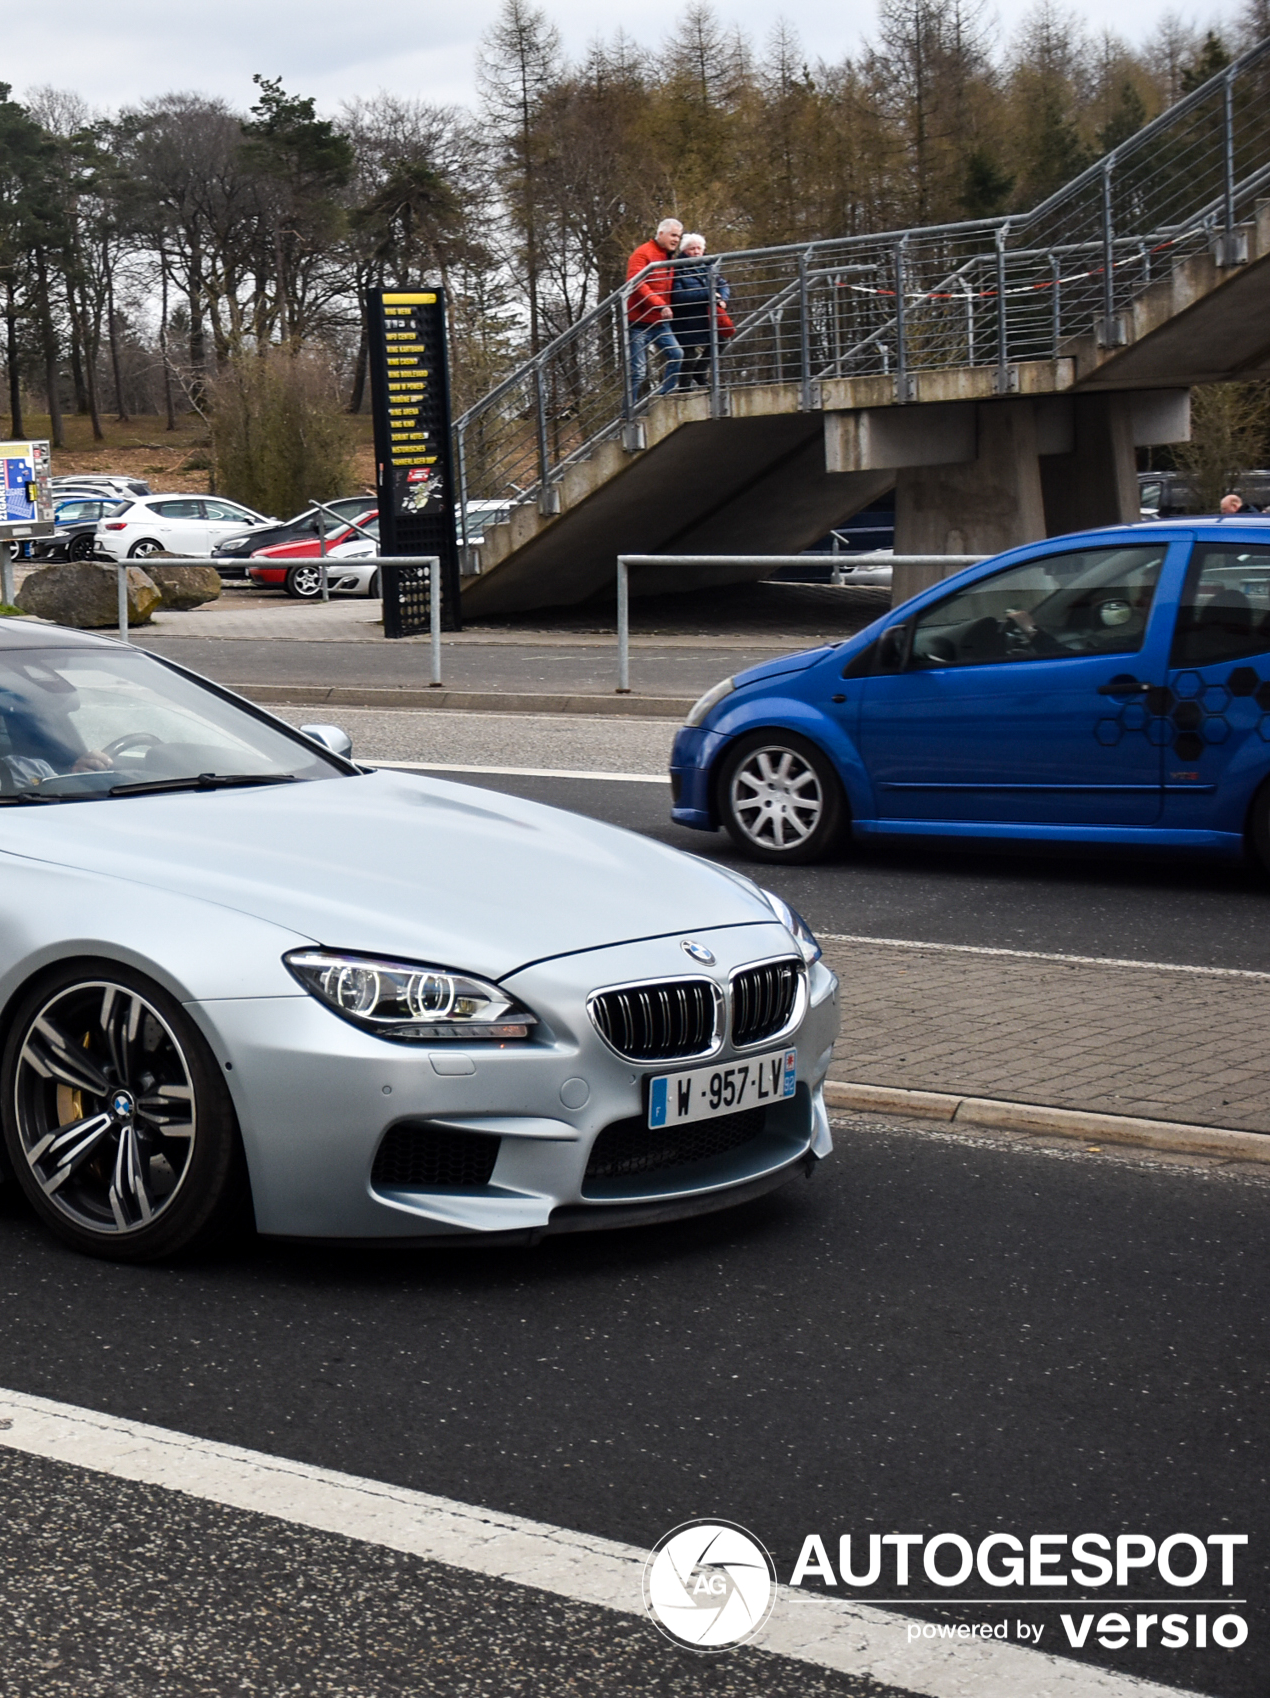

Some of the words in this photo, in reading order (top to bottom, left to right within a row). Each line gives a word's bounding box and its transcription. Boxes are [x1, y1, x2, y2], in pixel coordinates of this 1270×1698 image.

[397, 331, 417, 340] CENTER
[391, 444, 427, 454] HISTORISCHES
[784, 1075, 795, 1092] 92
[655, 1106, 662, 1118] F
